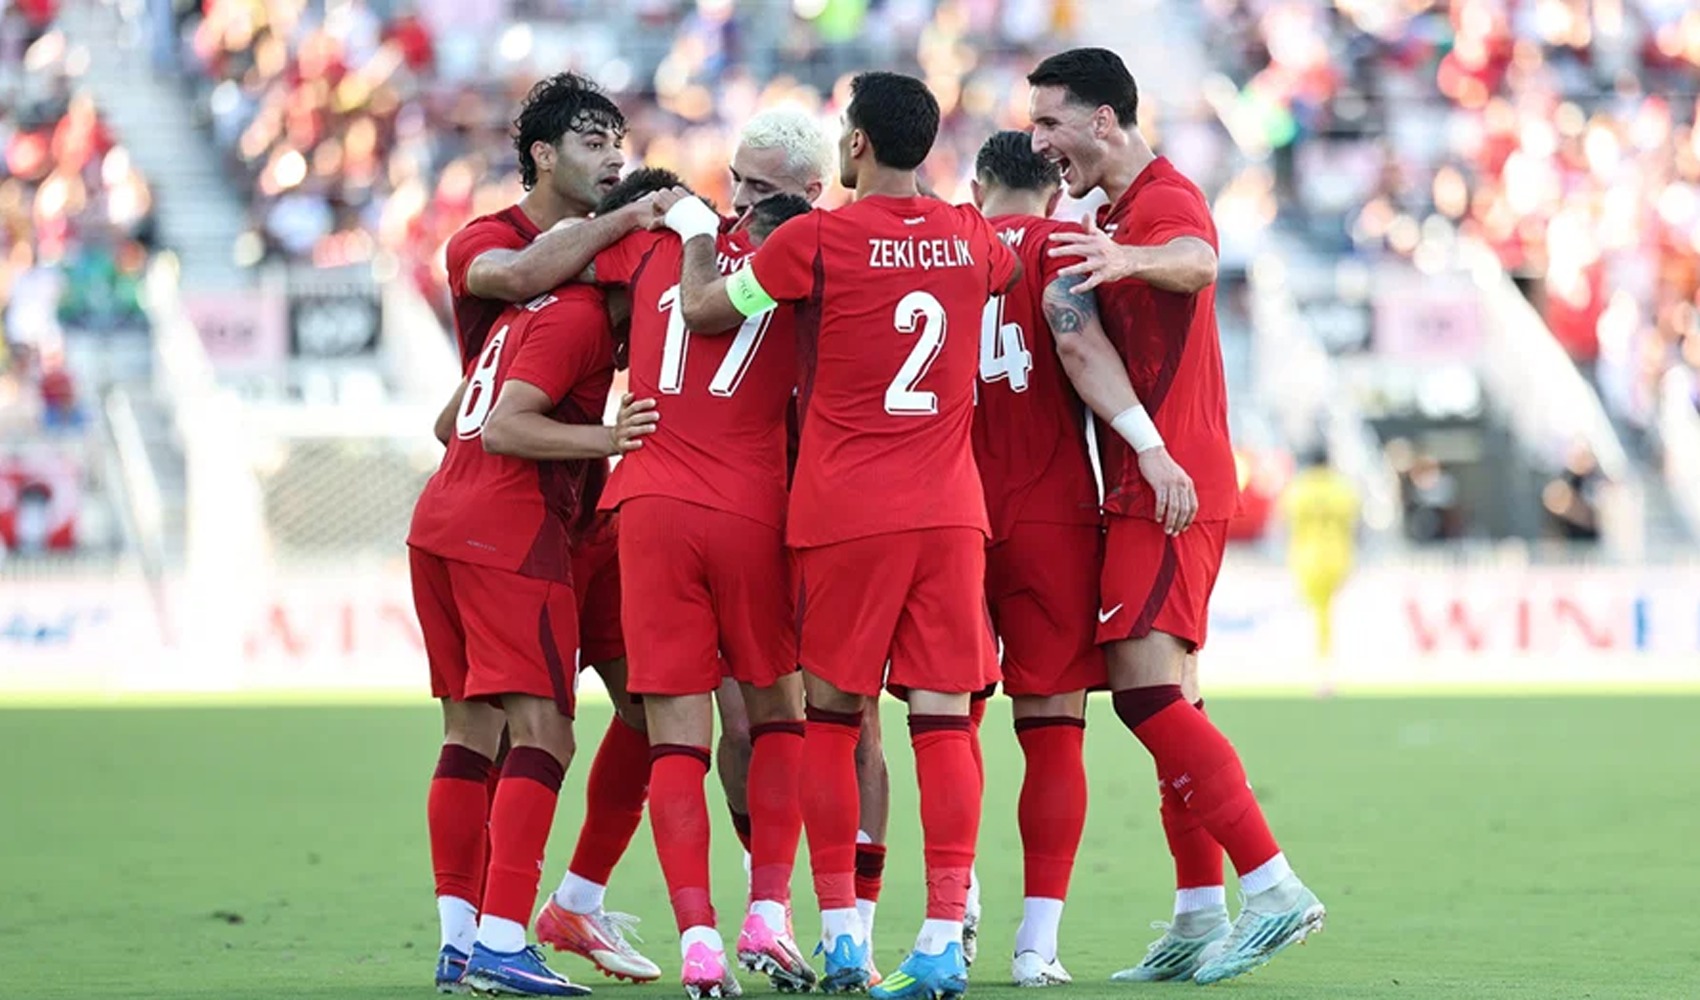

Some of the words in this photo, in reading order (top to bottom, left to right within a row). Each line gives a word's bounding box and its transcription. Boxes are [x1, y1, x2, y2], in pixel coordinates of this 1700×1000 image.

[868, 235, 915, 268] ZEKİ
[918, 234, 975, 270] ÇELİK
[456, 325, 509, 440] 8
[658, 284, 777, 397] 17
[884, 290, 947, 417] 2
[973, 294, 1033, 405] 4
